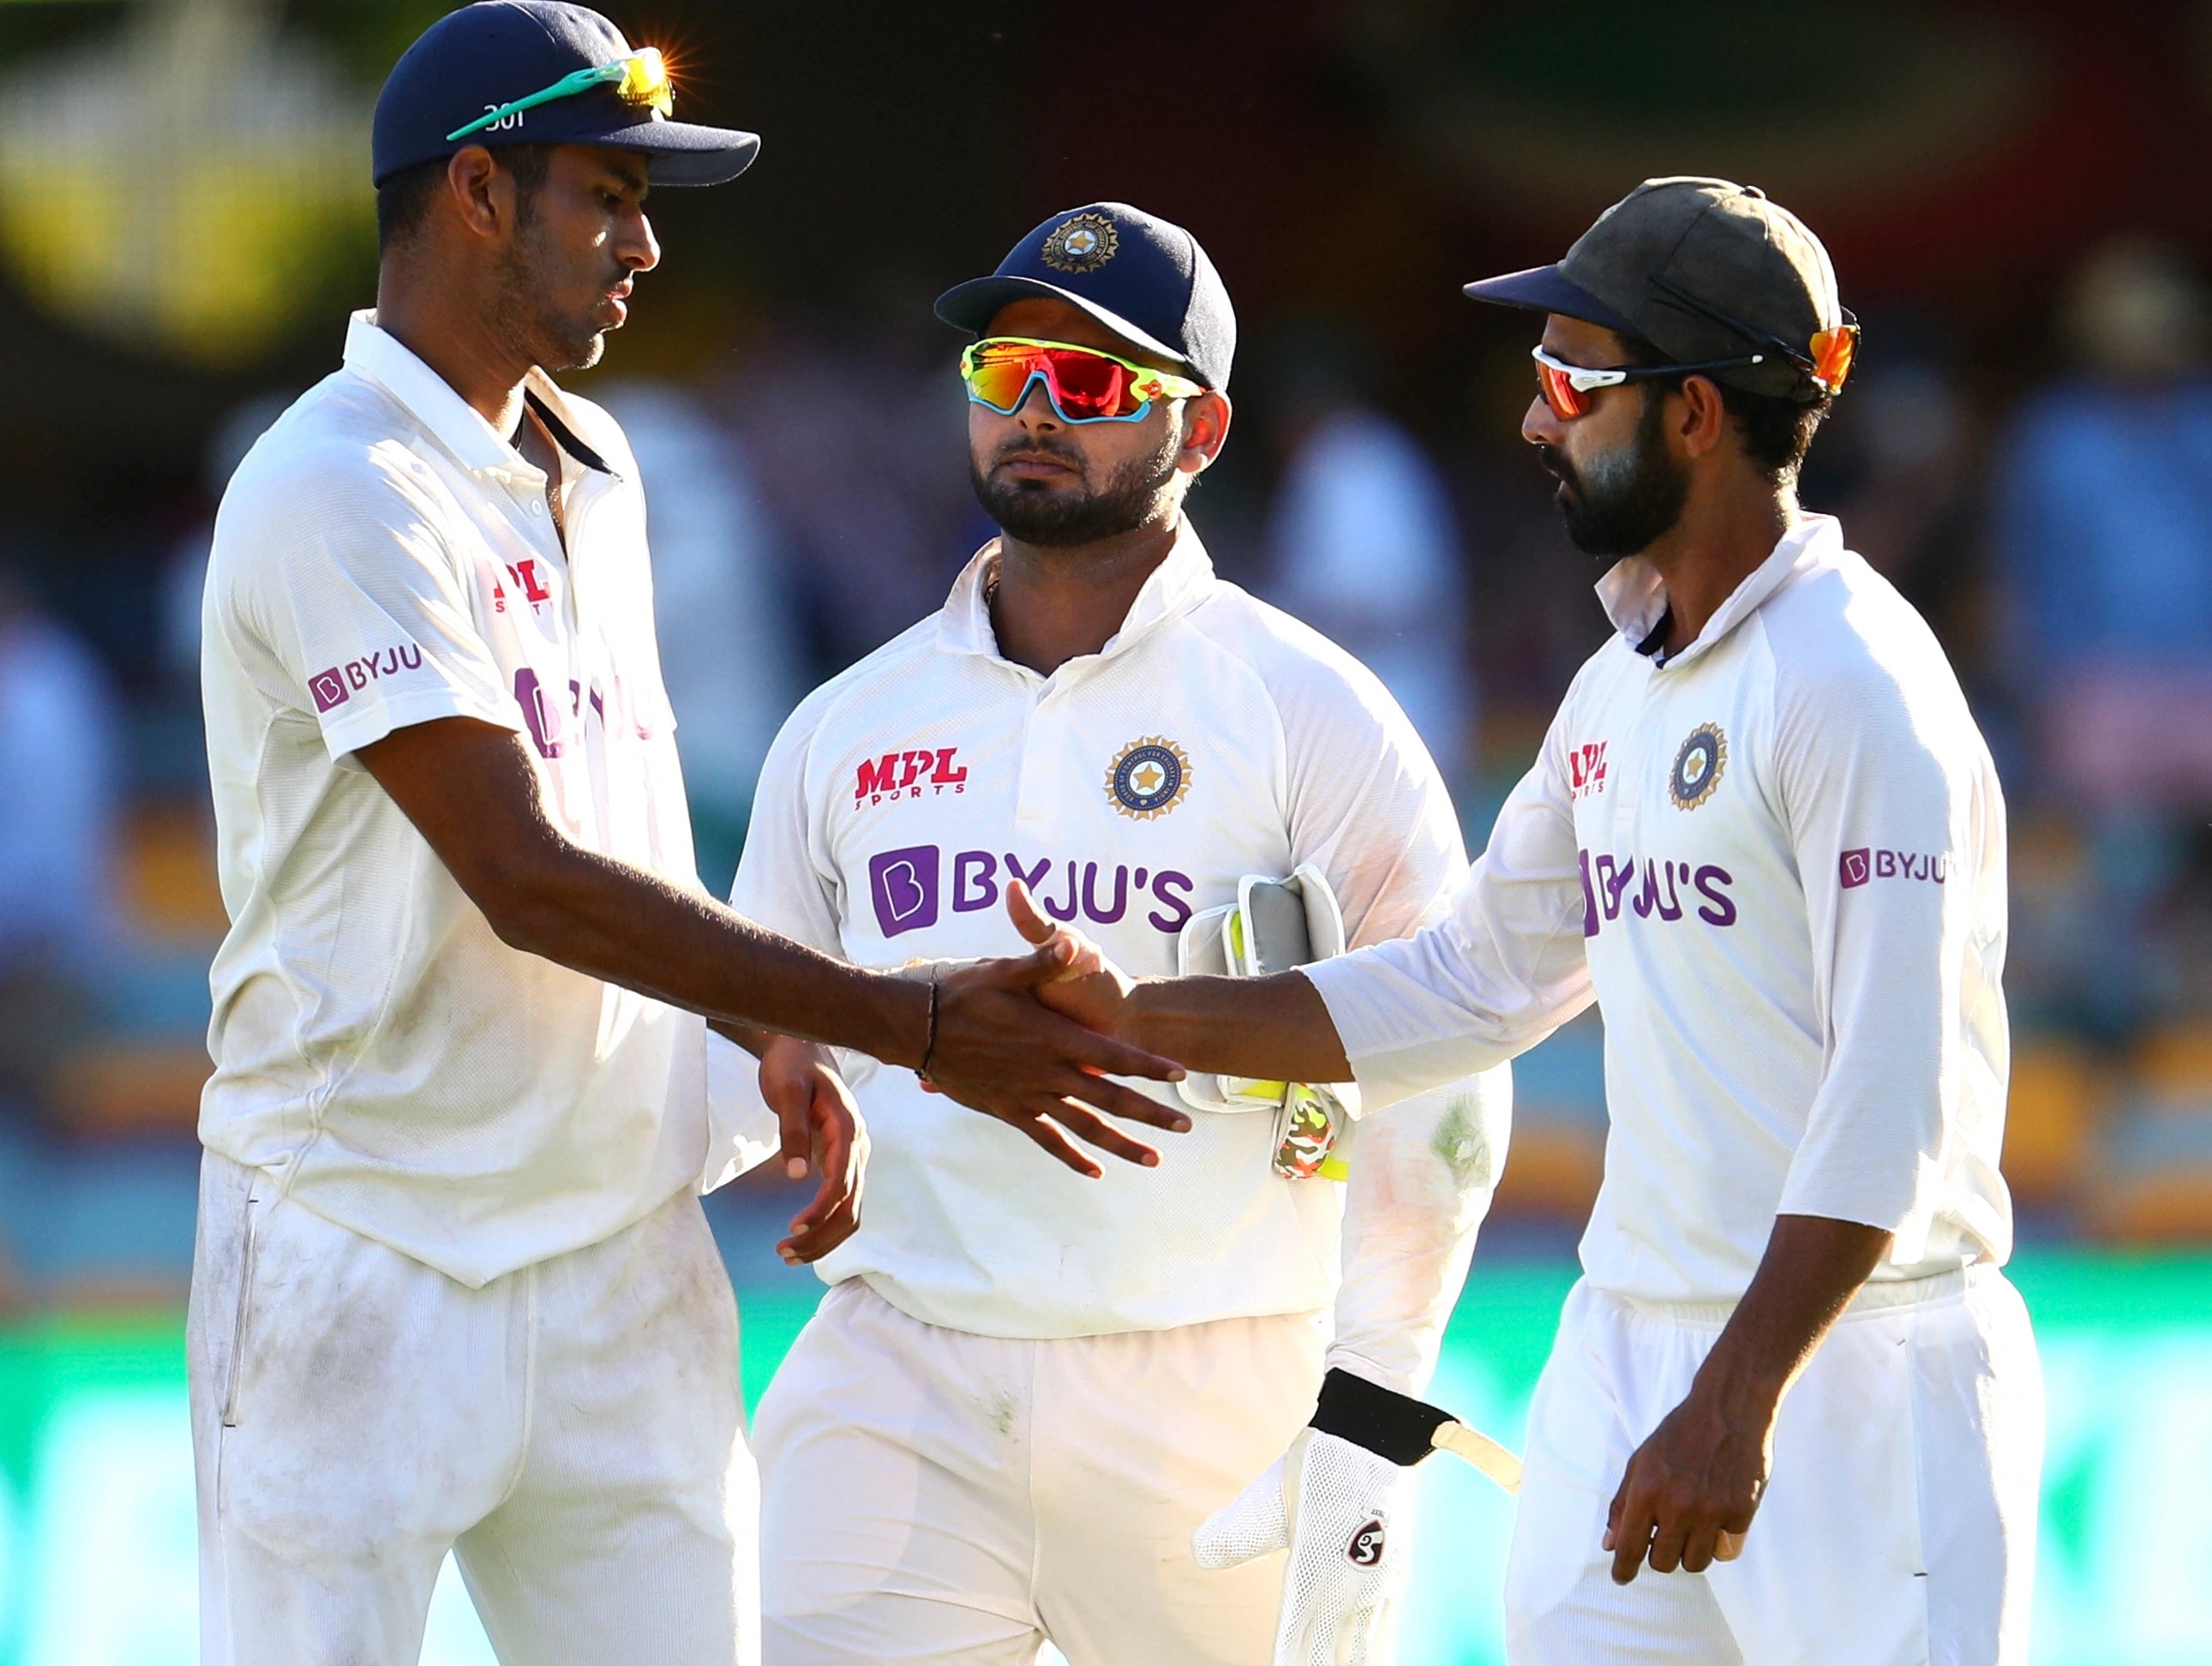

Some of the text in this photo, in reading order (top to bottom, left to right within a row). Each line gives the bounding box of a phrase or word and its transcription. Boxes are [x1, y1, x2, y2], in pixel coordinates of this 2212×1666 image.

[484, 103, 523, 131] 301
[855, 747, 968, 800] MPL
[952, 850, 1193, 933] BYJU'S
